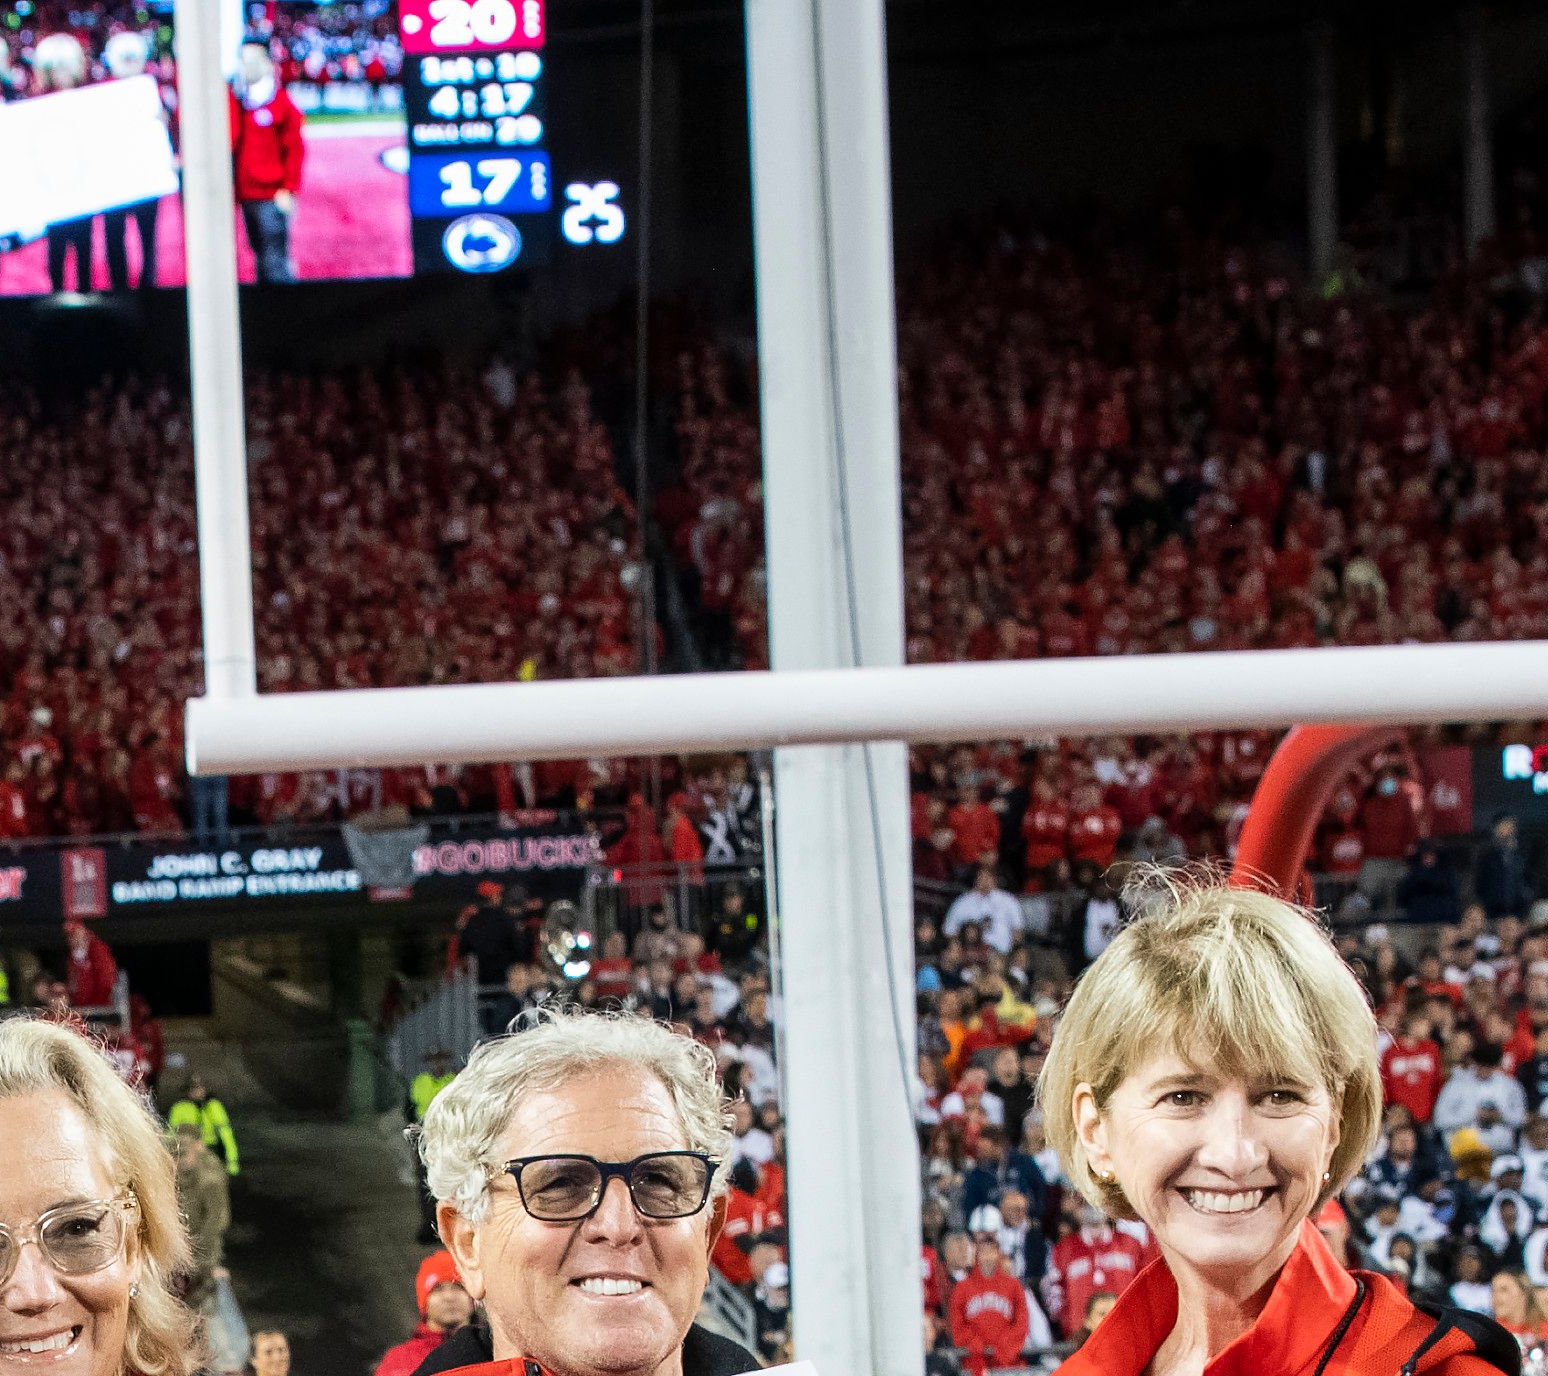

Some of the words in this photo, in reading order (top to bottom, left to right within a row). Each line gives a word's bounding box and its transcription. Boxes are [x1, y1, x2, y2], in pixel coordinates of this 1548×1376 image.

[427, 82, 534, 119] 4:17
[439, 158, 522, 208] 17
[250, 846, 324, 873] GRAY
